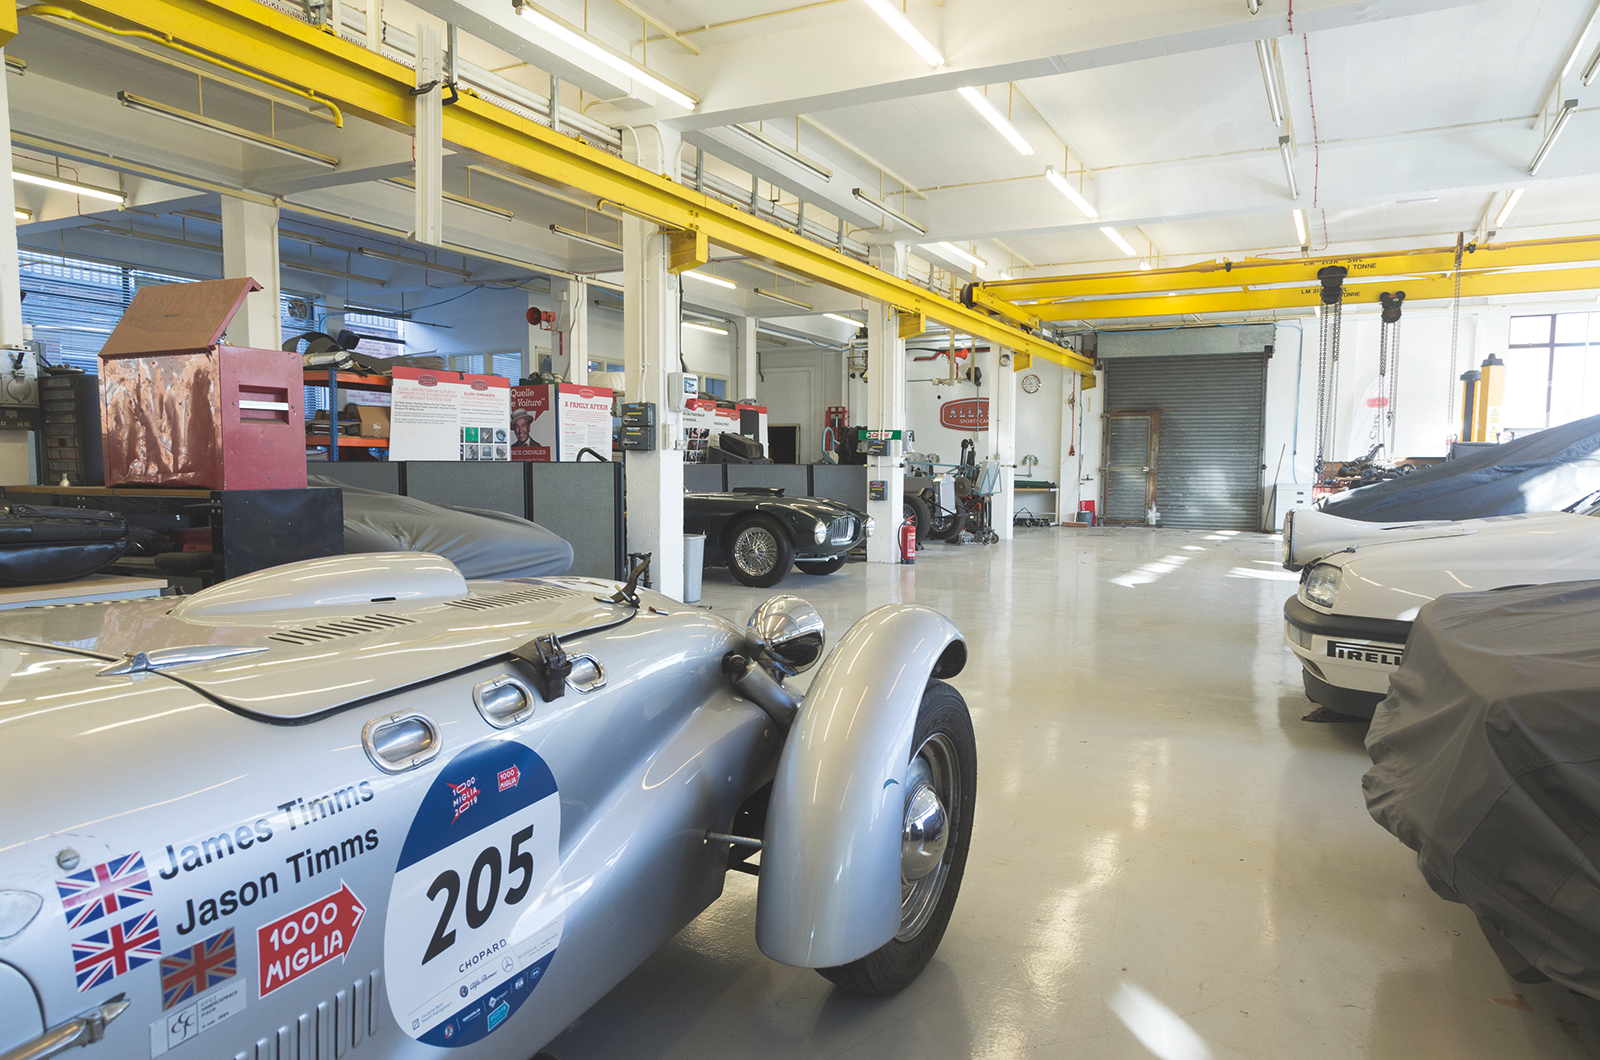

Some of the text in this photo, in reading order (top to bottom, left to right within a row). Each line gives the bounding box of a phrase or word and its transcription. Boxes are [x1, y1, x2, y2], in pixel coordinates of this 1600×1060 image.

[511, 388, 534, 398] Quelle
[1369, 414, 1381, 440] Cars
[452, 776, 476, 796] 1000
[500, 770, 515, 780] 1000
[500, 777, 516, 788] MIGLIA
[452, 786, 477, 807] MIGLIA
[454, 796, 478, 818] 2019
[158, 780, 375, 881] James Timms
[176, 827, 380, 936] Jason Timms
[421, 824, 535, 966] 205
[269, 902, 339, 952] 1000
[264, 929, 345, 989] MIGLIA
[458, 938, 507, 973] CHOPARD
